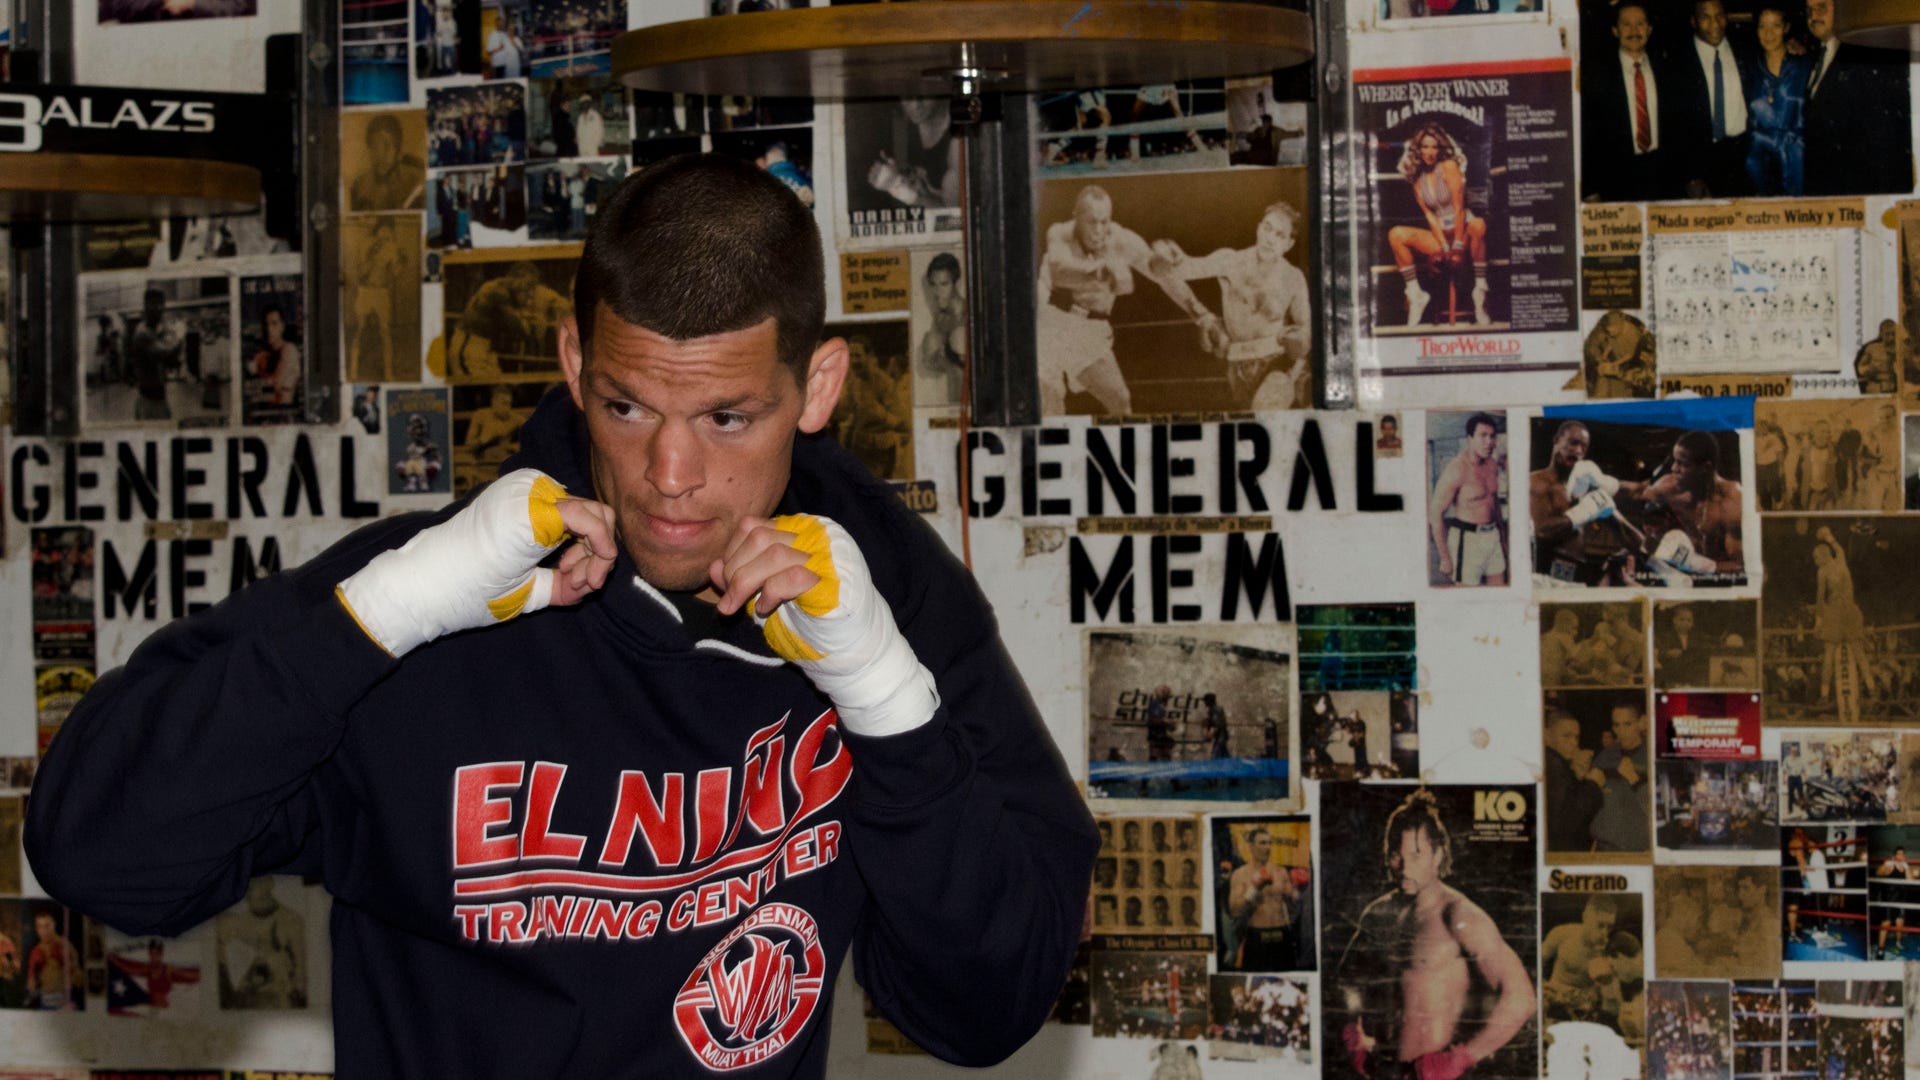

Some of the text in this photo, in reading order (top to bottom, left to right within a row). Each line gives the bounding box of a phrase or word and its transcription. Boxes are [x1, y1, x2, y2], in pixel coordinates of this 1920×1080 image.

[1358, 79, 1509, 103] WHERE EVERY WINNER
[0, 94, 215, 152] BALAZS
[851, 222, 926, 238] ROMERO
[1601, 222, 1641, 235] Trinidad
[1651, 212, 1688, 229] "Nada
[1692, 211, 1741, 230] seguro"
[1784, 209, 1822, 225] Winky
[1826, 211, 1834, 223] y
[1838, 206, 1864, 222] Tito
[1610, 239, 1641, 254] Winky
[1720, 384, 1730, 396] a
[11, 433, 380, 522] GENERAL
[957, 418, 1405, 518] GENERAL
[1069, 532, 1293, 623] MEM
[1671, 737, 1743, 749] TEMPORARY
[453, 707, 855, 868] EL NIÑO
[1474, 790, 1527, 822] KO
[667, 820, 842, 932] CENTER
[1550, 868, 1628, 891] Serrano
[701, 1032, 788, 1067] MUAY THAI
